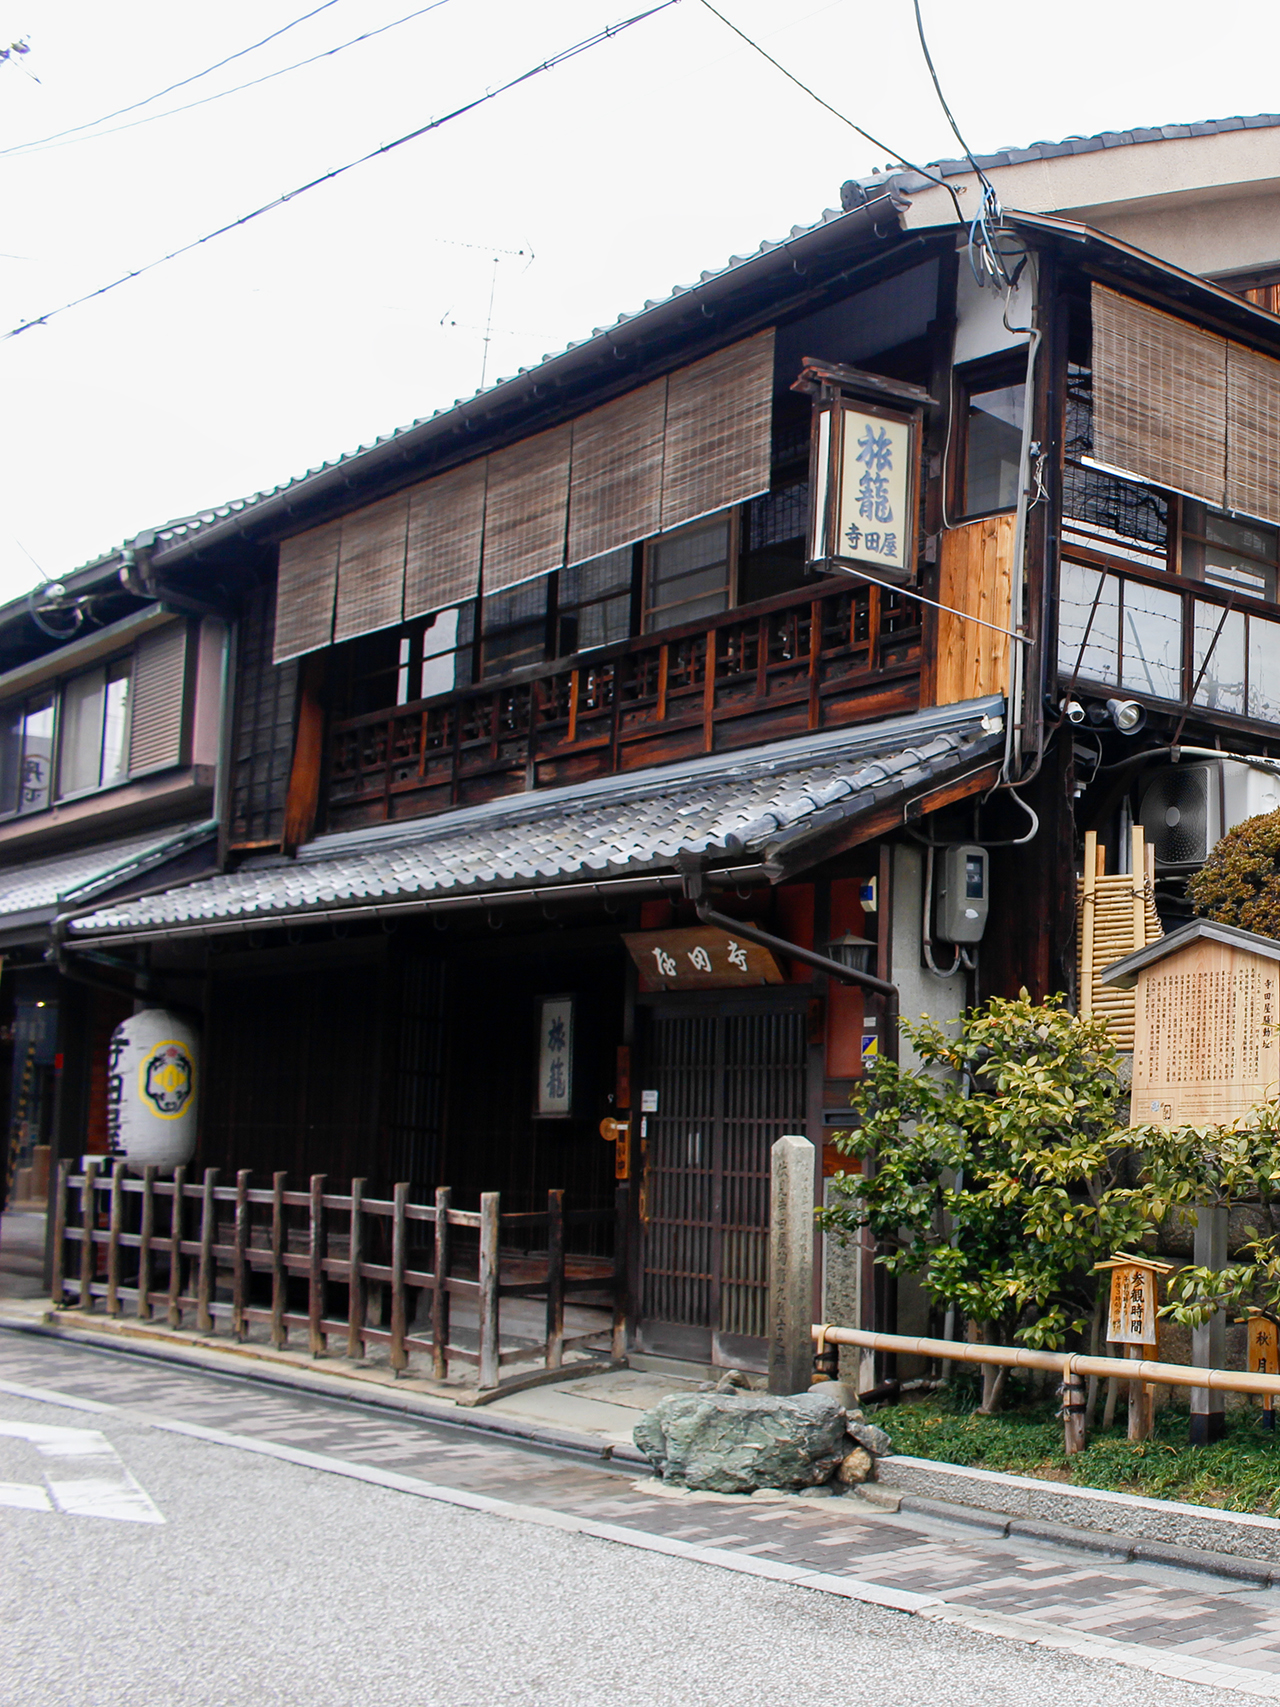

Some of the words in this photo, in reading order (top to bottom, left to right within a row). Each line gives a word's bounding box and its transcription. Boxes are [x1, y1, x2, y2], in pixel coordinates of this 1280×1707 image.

[855, 424, 894, 523] 旅籠
[844, 523, 898, 558] 寺田屋
[1130, 1271, 1146, 1335] 参観時間
[1256, 1331, 1270, 1373] 秋月
